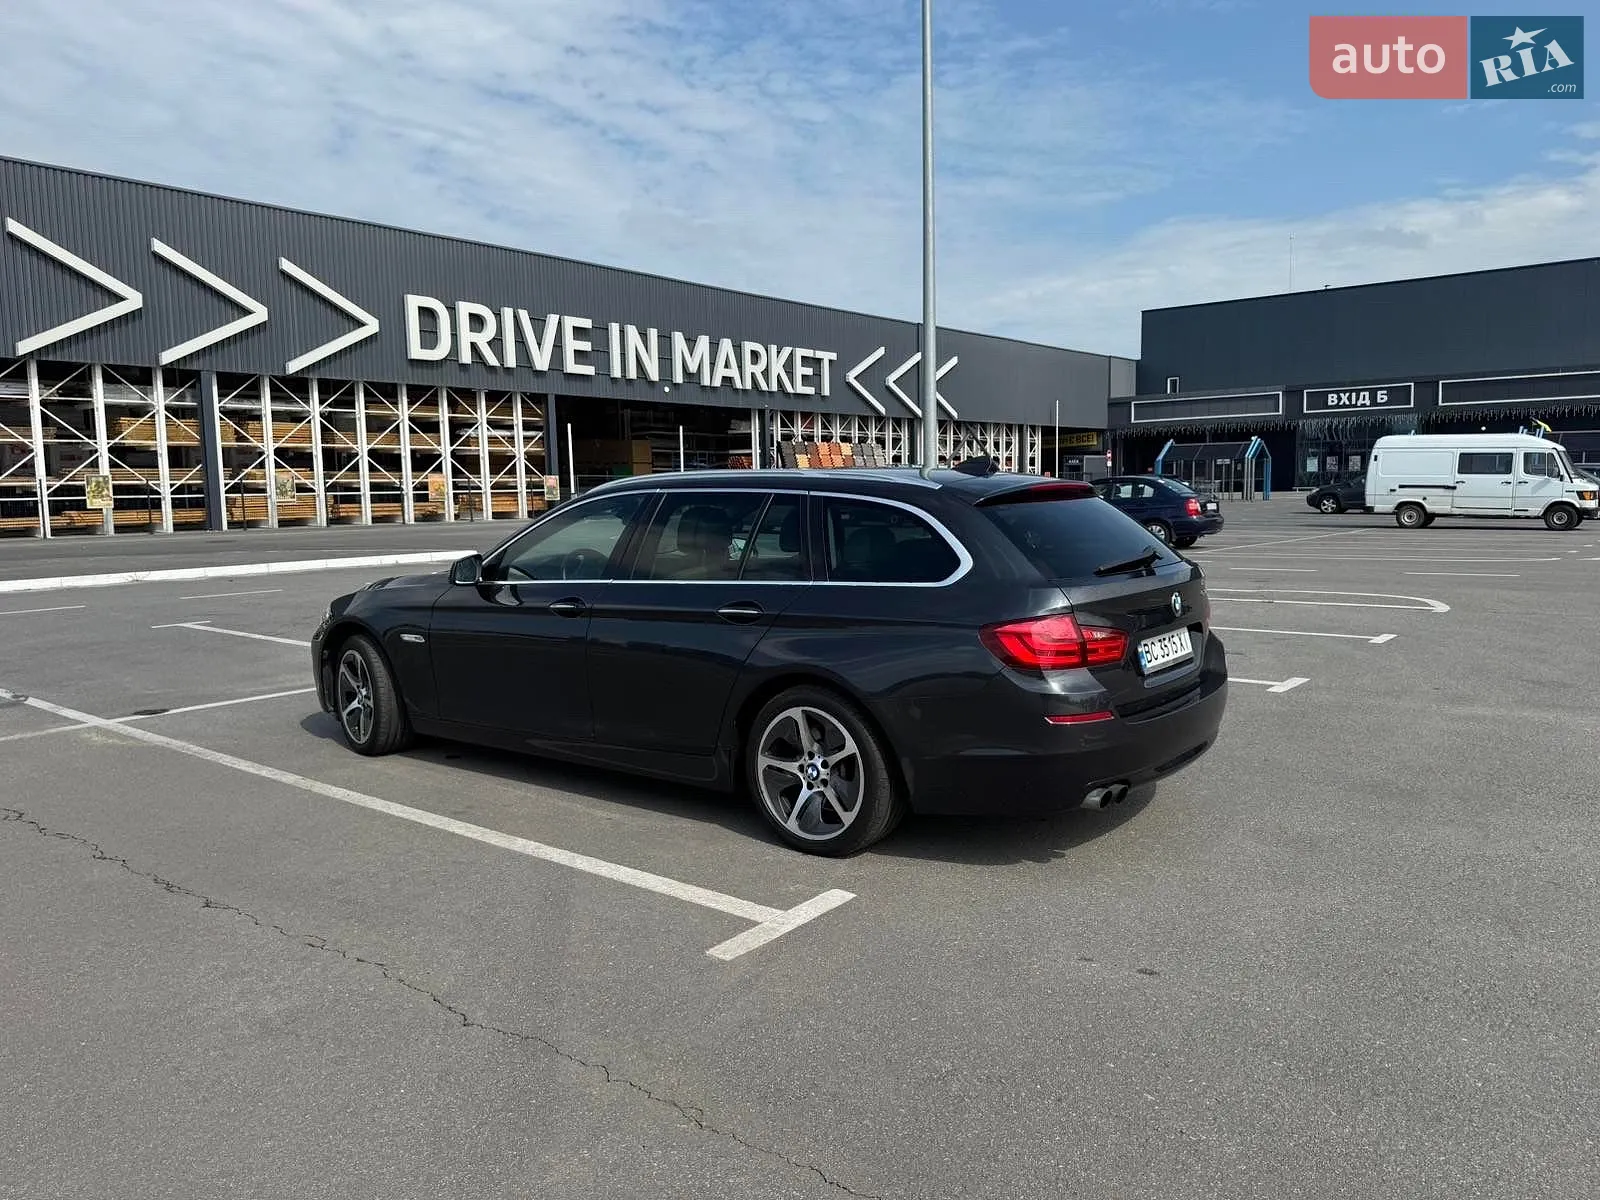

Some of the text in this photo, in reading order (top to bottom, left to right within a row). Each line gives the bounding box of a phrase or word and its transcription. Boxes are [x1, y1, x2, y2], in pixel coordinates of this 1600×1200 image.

[403, 293, 838, 397] DRIVE IN MARKET
[1327, 390, 1388, 406] ВХІД Б
[1143, 641, 1159, 664] BC
[1158, 634, 1179, 658] 3515
